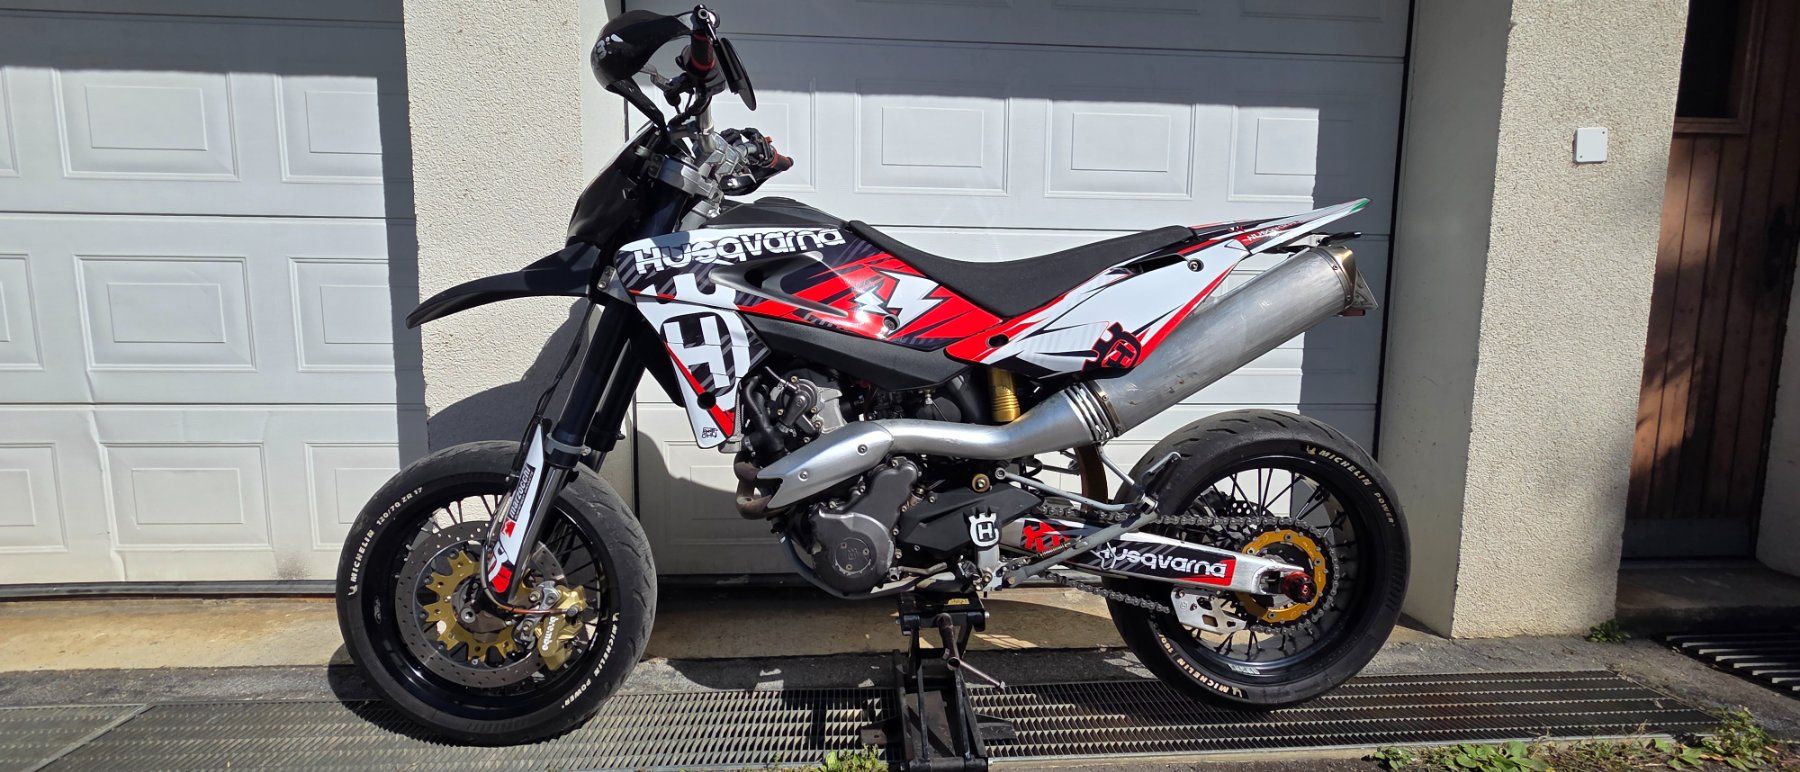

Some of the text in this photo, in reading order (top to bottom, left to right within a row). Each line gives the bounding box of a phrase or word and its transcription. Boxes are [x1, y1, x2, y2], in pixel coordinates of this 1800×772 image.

[633, 228, 847, 275] Husqvarna
[509, 465, 531, 518] marzocchi
[1318, 450, 1395, 523] MICHELIN POWER
[350, 486, 423, 582] MICHELIN 120/70 ZR 17
[977, 522, 993, 540] H
[541, 616, 559, 651] brembo
[564, 624, 618, 706] MICHELIN POWER
[1176, 657, 1230, 694] MICHELIN
